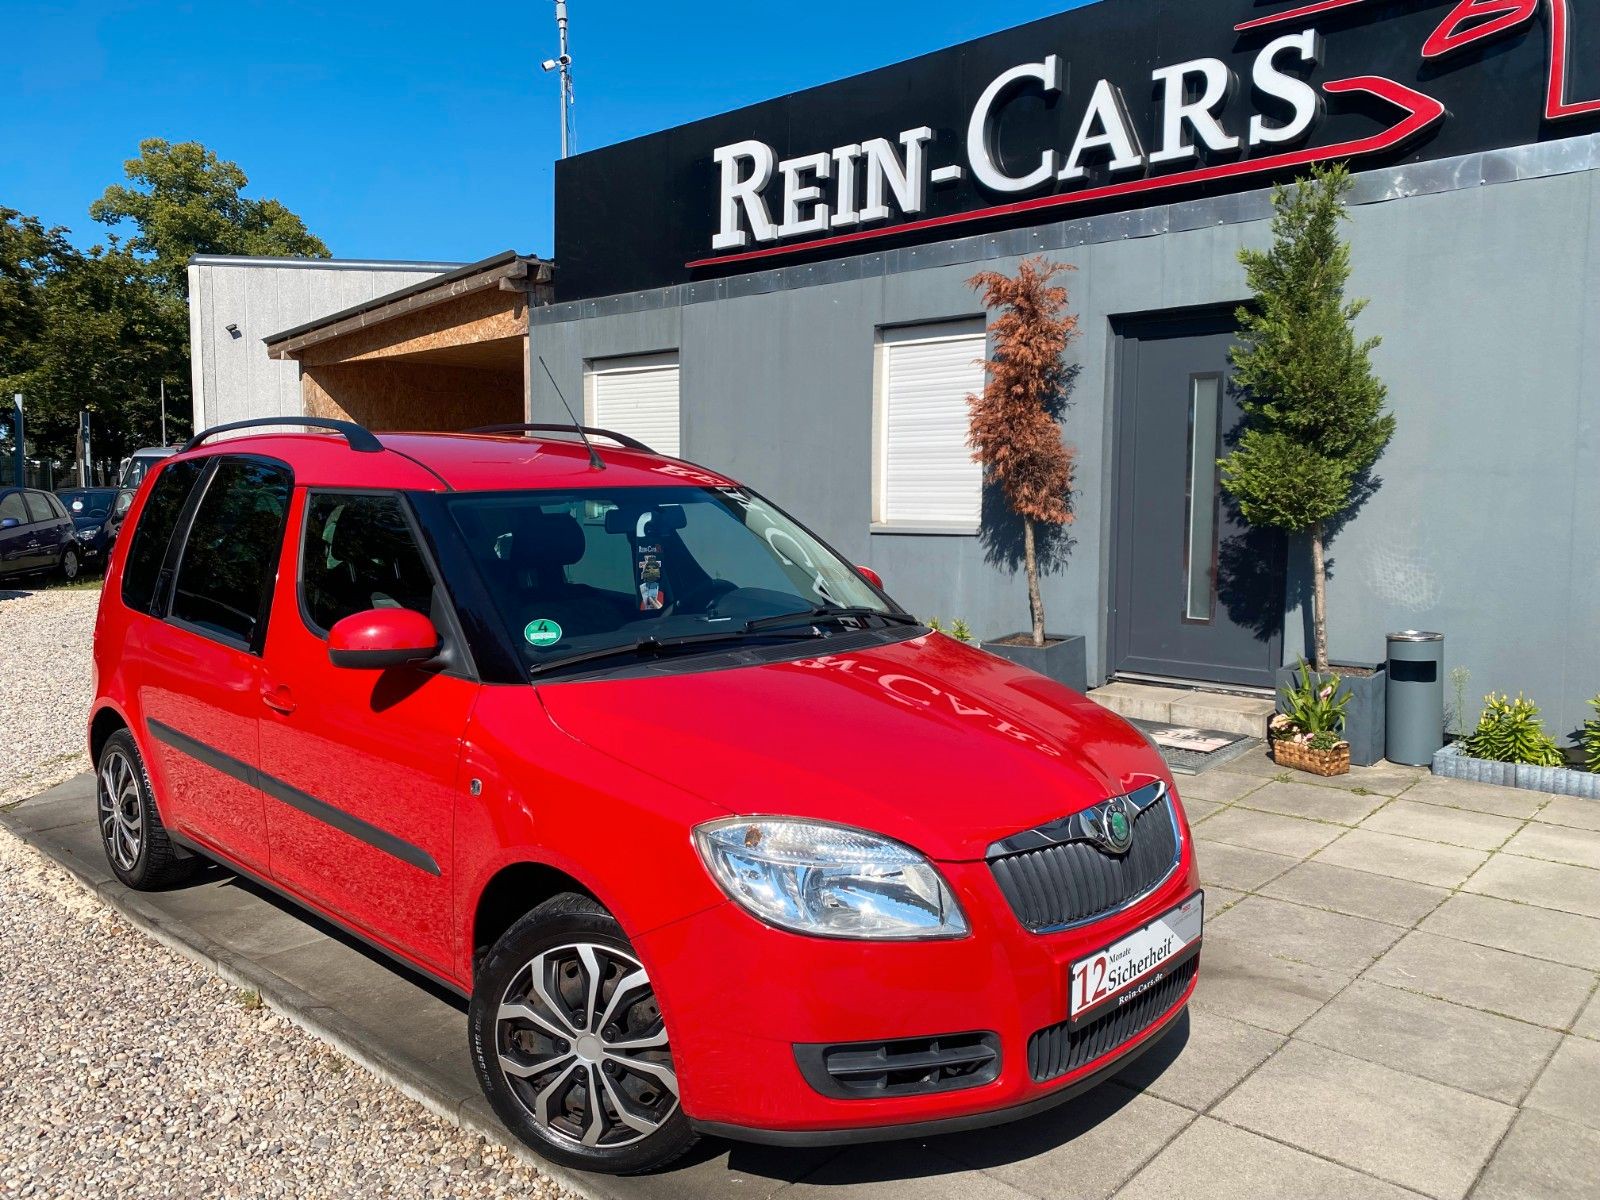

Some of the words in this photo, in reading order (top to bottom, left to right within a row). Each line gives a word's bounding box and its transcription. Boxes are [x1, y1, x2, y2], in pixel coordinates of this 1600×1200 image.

[712, 28, 1318, 250] REIN-CARS
[538, 620, 548, 632] 4
[1108, 937, 1172, 991] Sicherheit
[1109, 947, 1131, 965] Monate
[1076, 956, 1107, 1011] 12
[1118, 973, 1163, 1006] Rein-Cars.de
